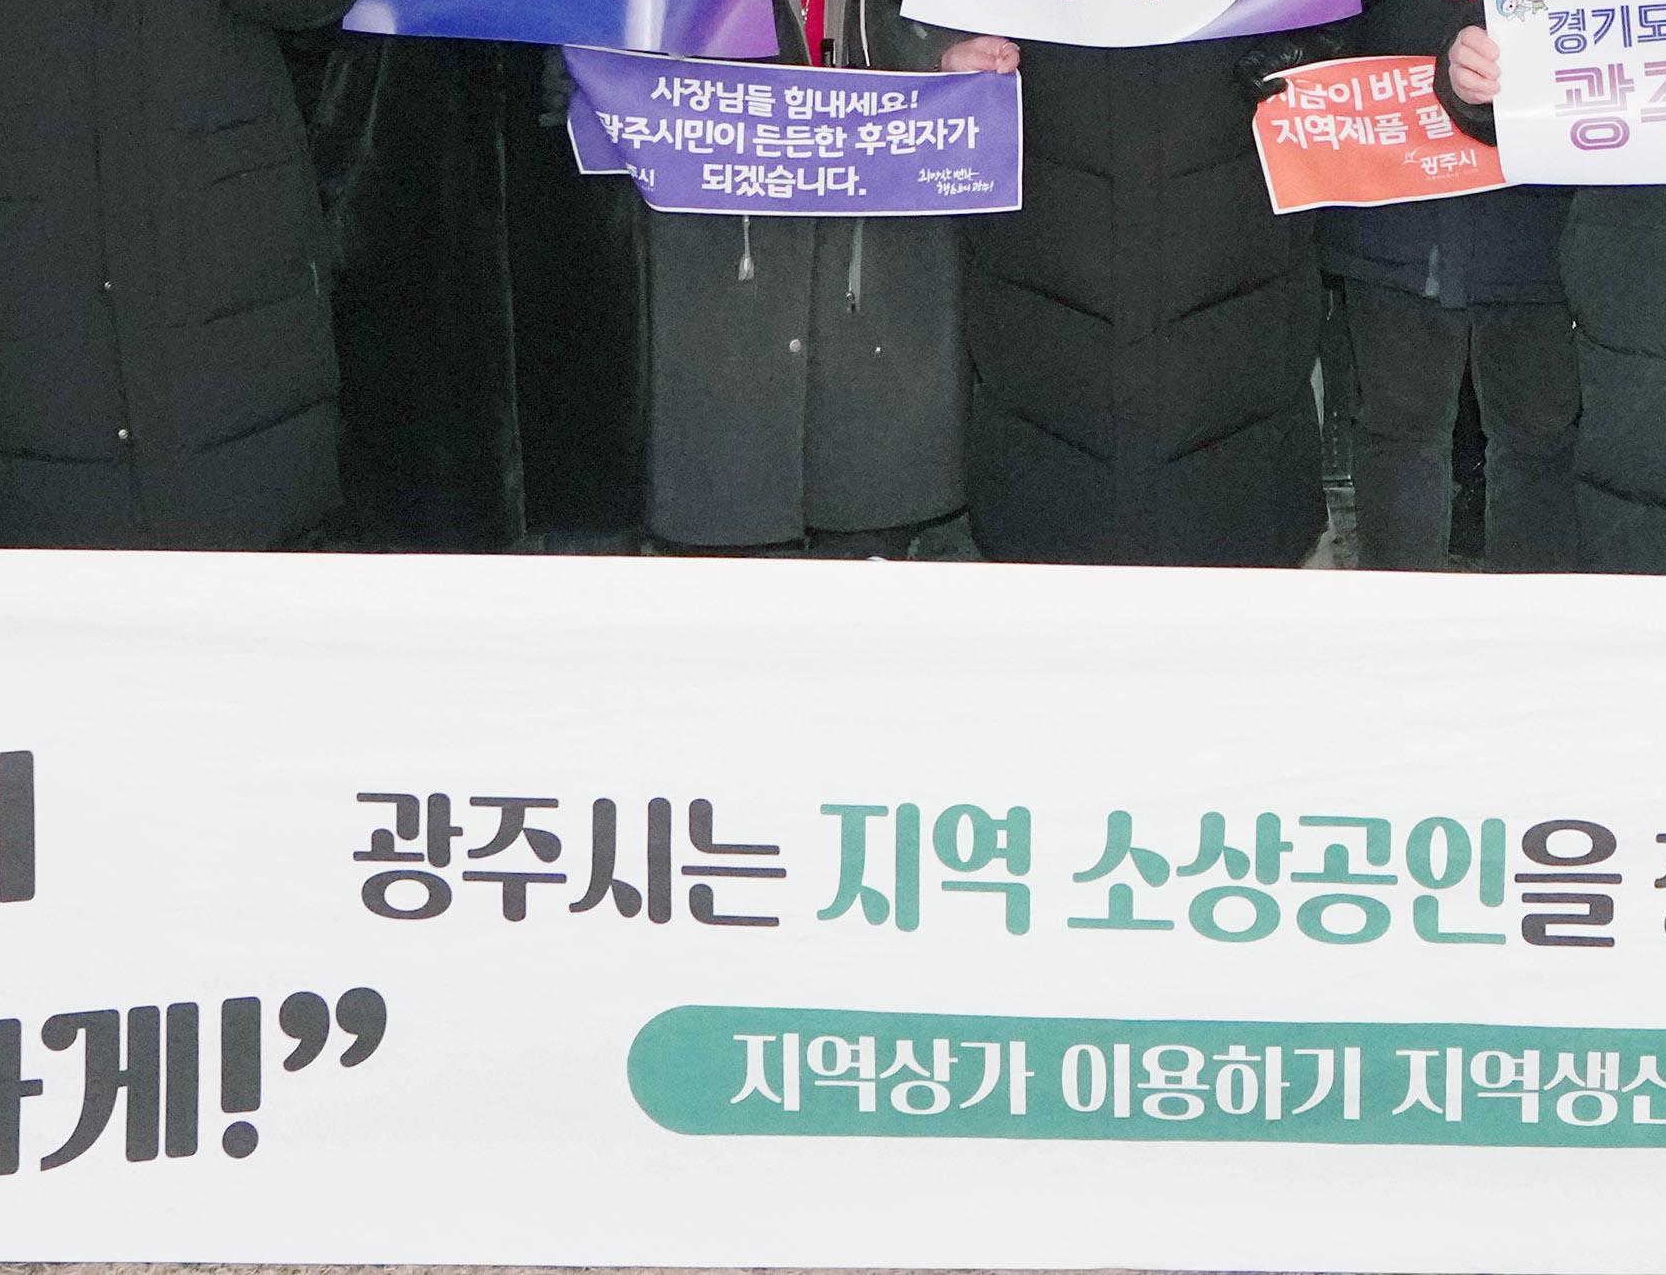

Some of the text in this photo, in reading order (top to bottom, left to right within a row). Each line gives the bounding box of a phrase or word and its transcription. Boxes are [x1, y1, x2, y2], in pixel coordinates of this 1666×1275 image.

[651, 77, 919, 118] 사장님들 힘내세요!
[753, 113, 979, 156] 든든한 후원자가
[1275, 108, 1409, 150] 지역제품
[702, 163, 867, 197] 되겠습니다.
[1419, 152, 1477, 173] 광주시
[353, 792, 786, 927] 광주시는
[815, 802, 1031, 935] 지역
[1066, 803, 1623, 949] 소상공인을
[731, 1033, 1035, 1115] 지역상가
[1061, 1042, 1361, 1122] 이용하기
